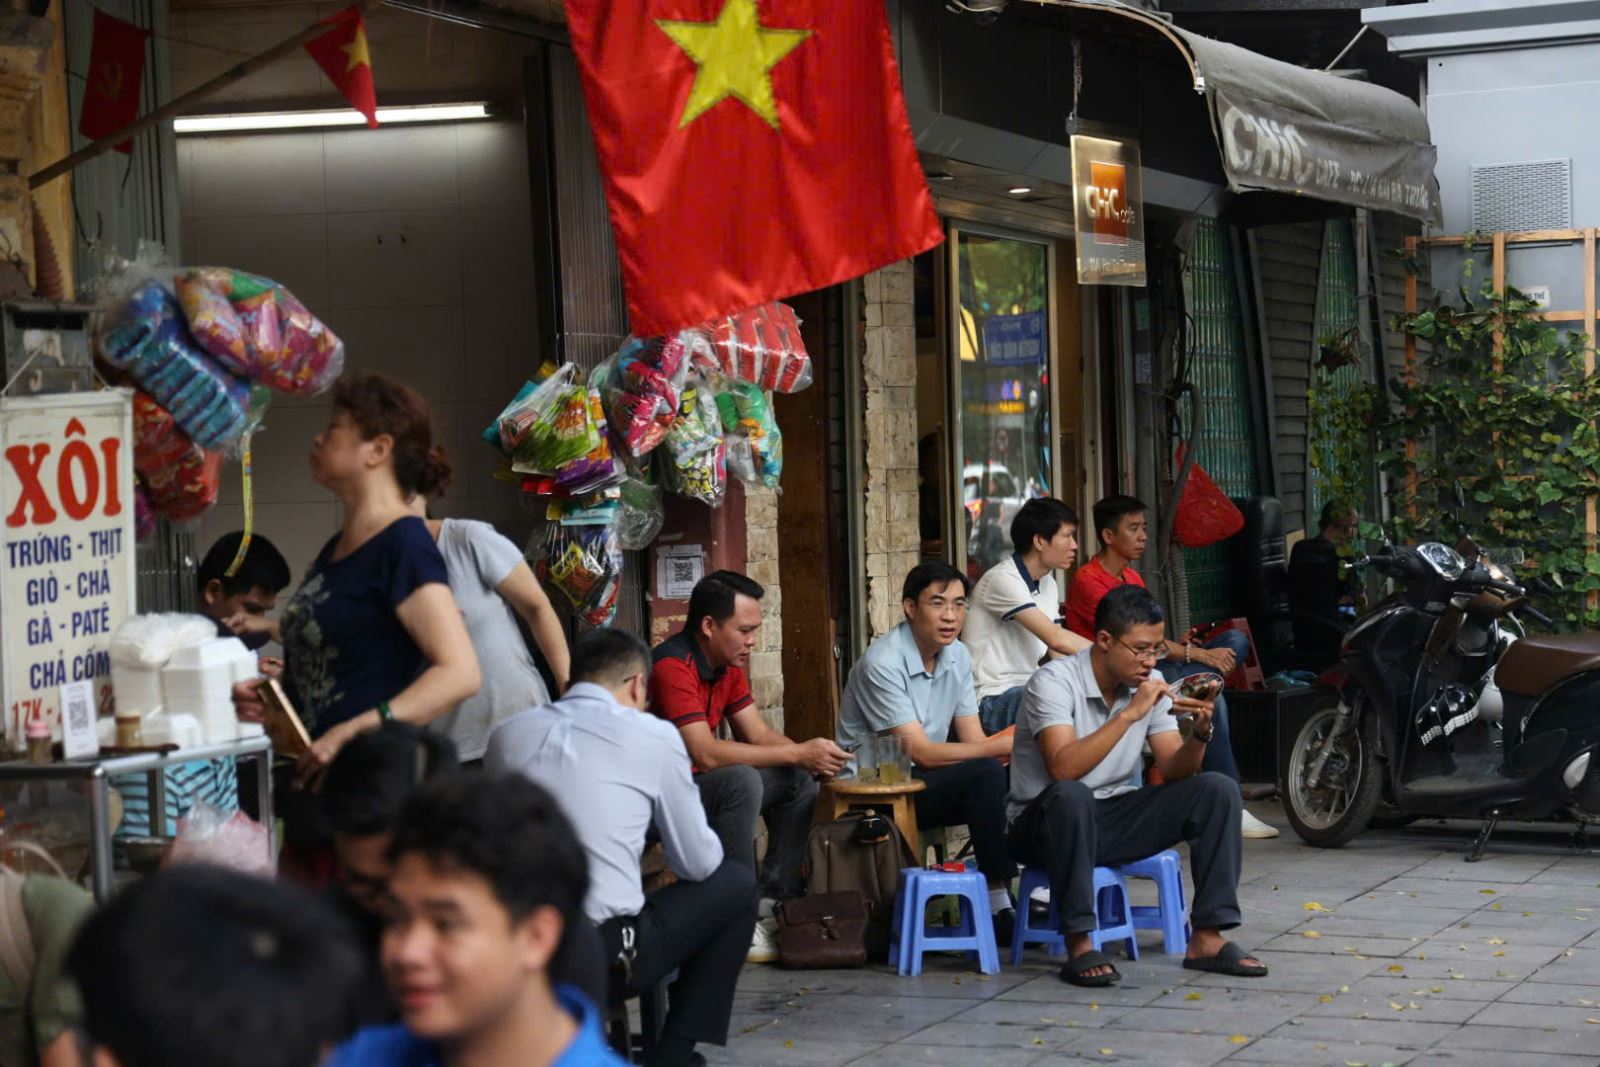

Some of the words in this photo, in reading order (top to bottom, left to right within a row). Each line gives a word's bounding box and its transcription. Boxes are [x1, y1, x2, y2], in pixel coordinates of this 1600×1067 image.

[5, 416, 122, 528] XÔI
[6, 532, 72, 569] TRỨNG
[88, 527, 123, 560] THỊT
[26, 570, 59, 607] GIÒ
[77, 558, 111, 599] CHẢ
[27, 609, 53, 646] GÀ
[30, 649, 67, 691] CHẢ
[72, 644, 111, 682] CỐM
